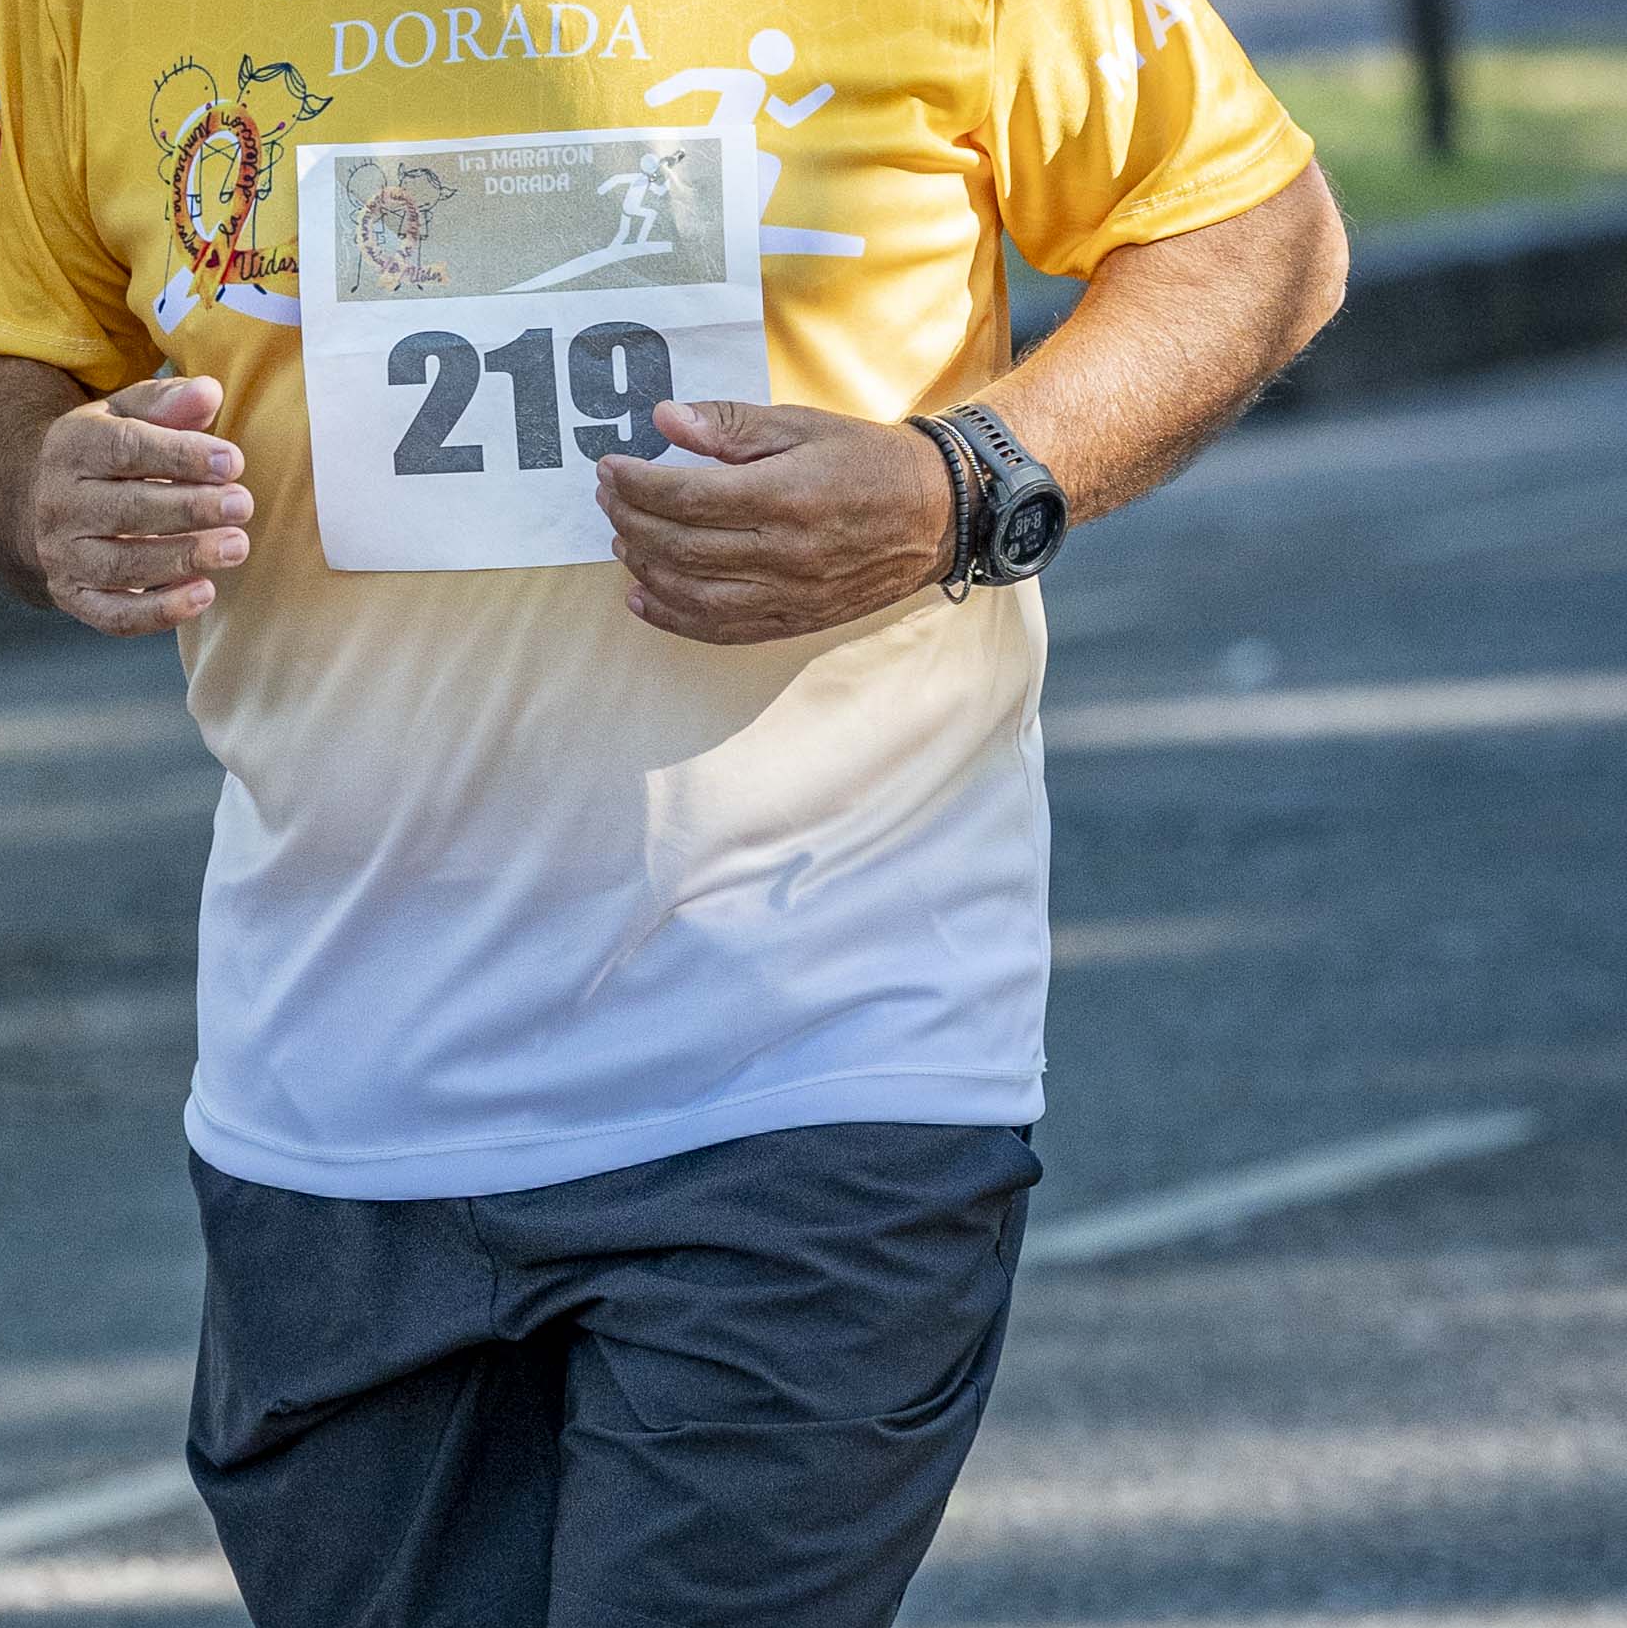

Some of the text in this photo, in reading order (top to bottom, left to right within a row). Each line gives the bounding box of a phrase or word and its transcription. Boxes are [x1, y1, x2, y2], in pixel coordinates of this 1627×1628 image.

[328, 2, 653, 77] DORADA
[490, 145, 594, 171] MARATON
[484, 173, 570, 195] DORADA
[387, 321, 674, 475] 219
[1015, 511, 1042, 537] 8:48
